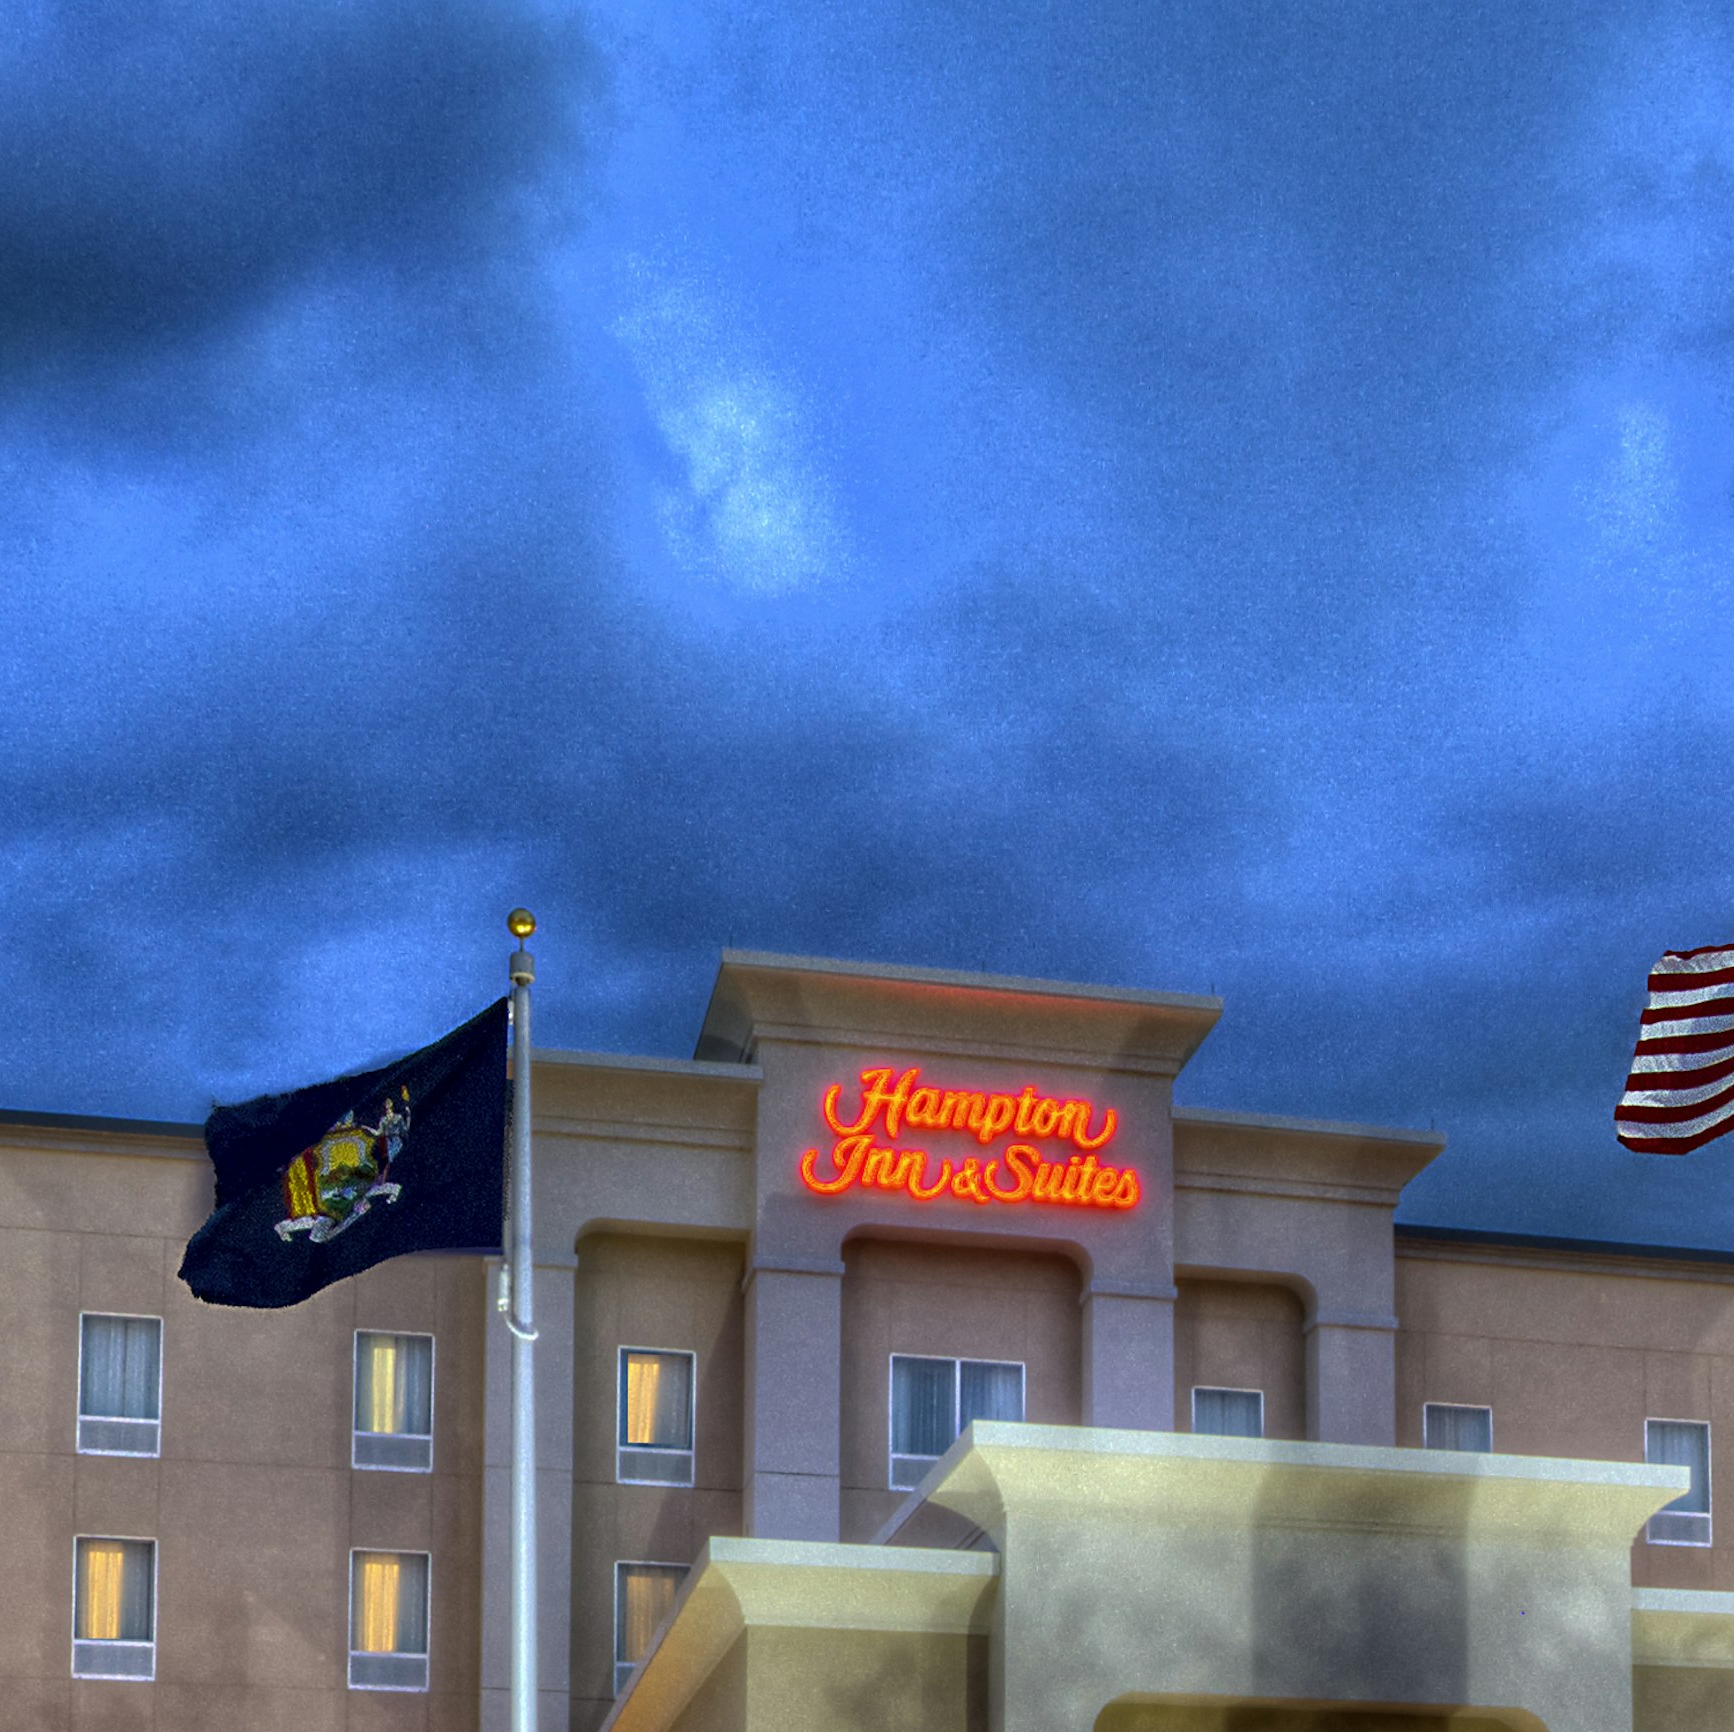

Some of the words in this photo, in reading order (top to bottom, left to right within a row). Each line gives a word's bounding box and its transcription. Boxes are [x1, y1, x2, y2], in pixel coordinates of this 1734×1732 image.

[823, 1067, 1117, 1150] Hampton
[801, 1134, 953, 1199] Inn
[950, 1156, 989, 1204] &
[983, 1143, 1141, 1210] Suites
